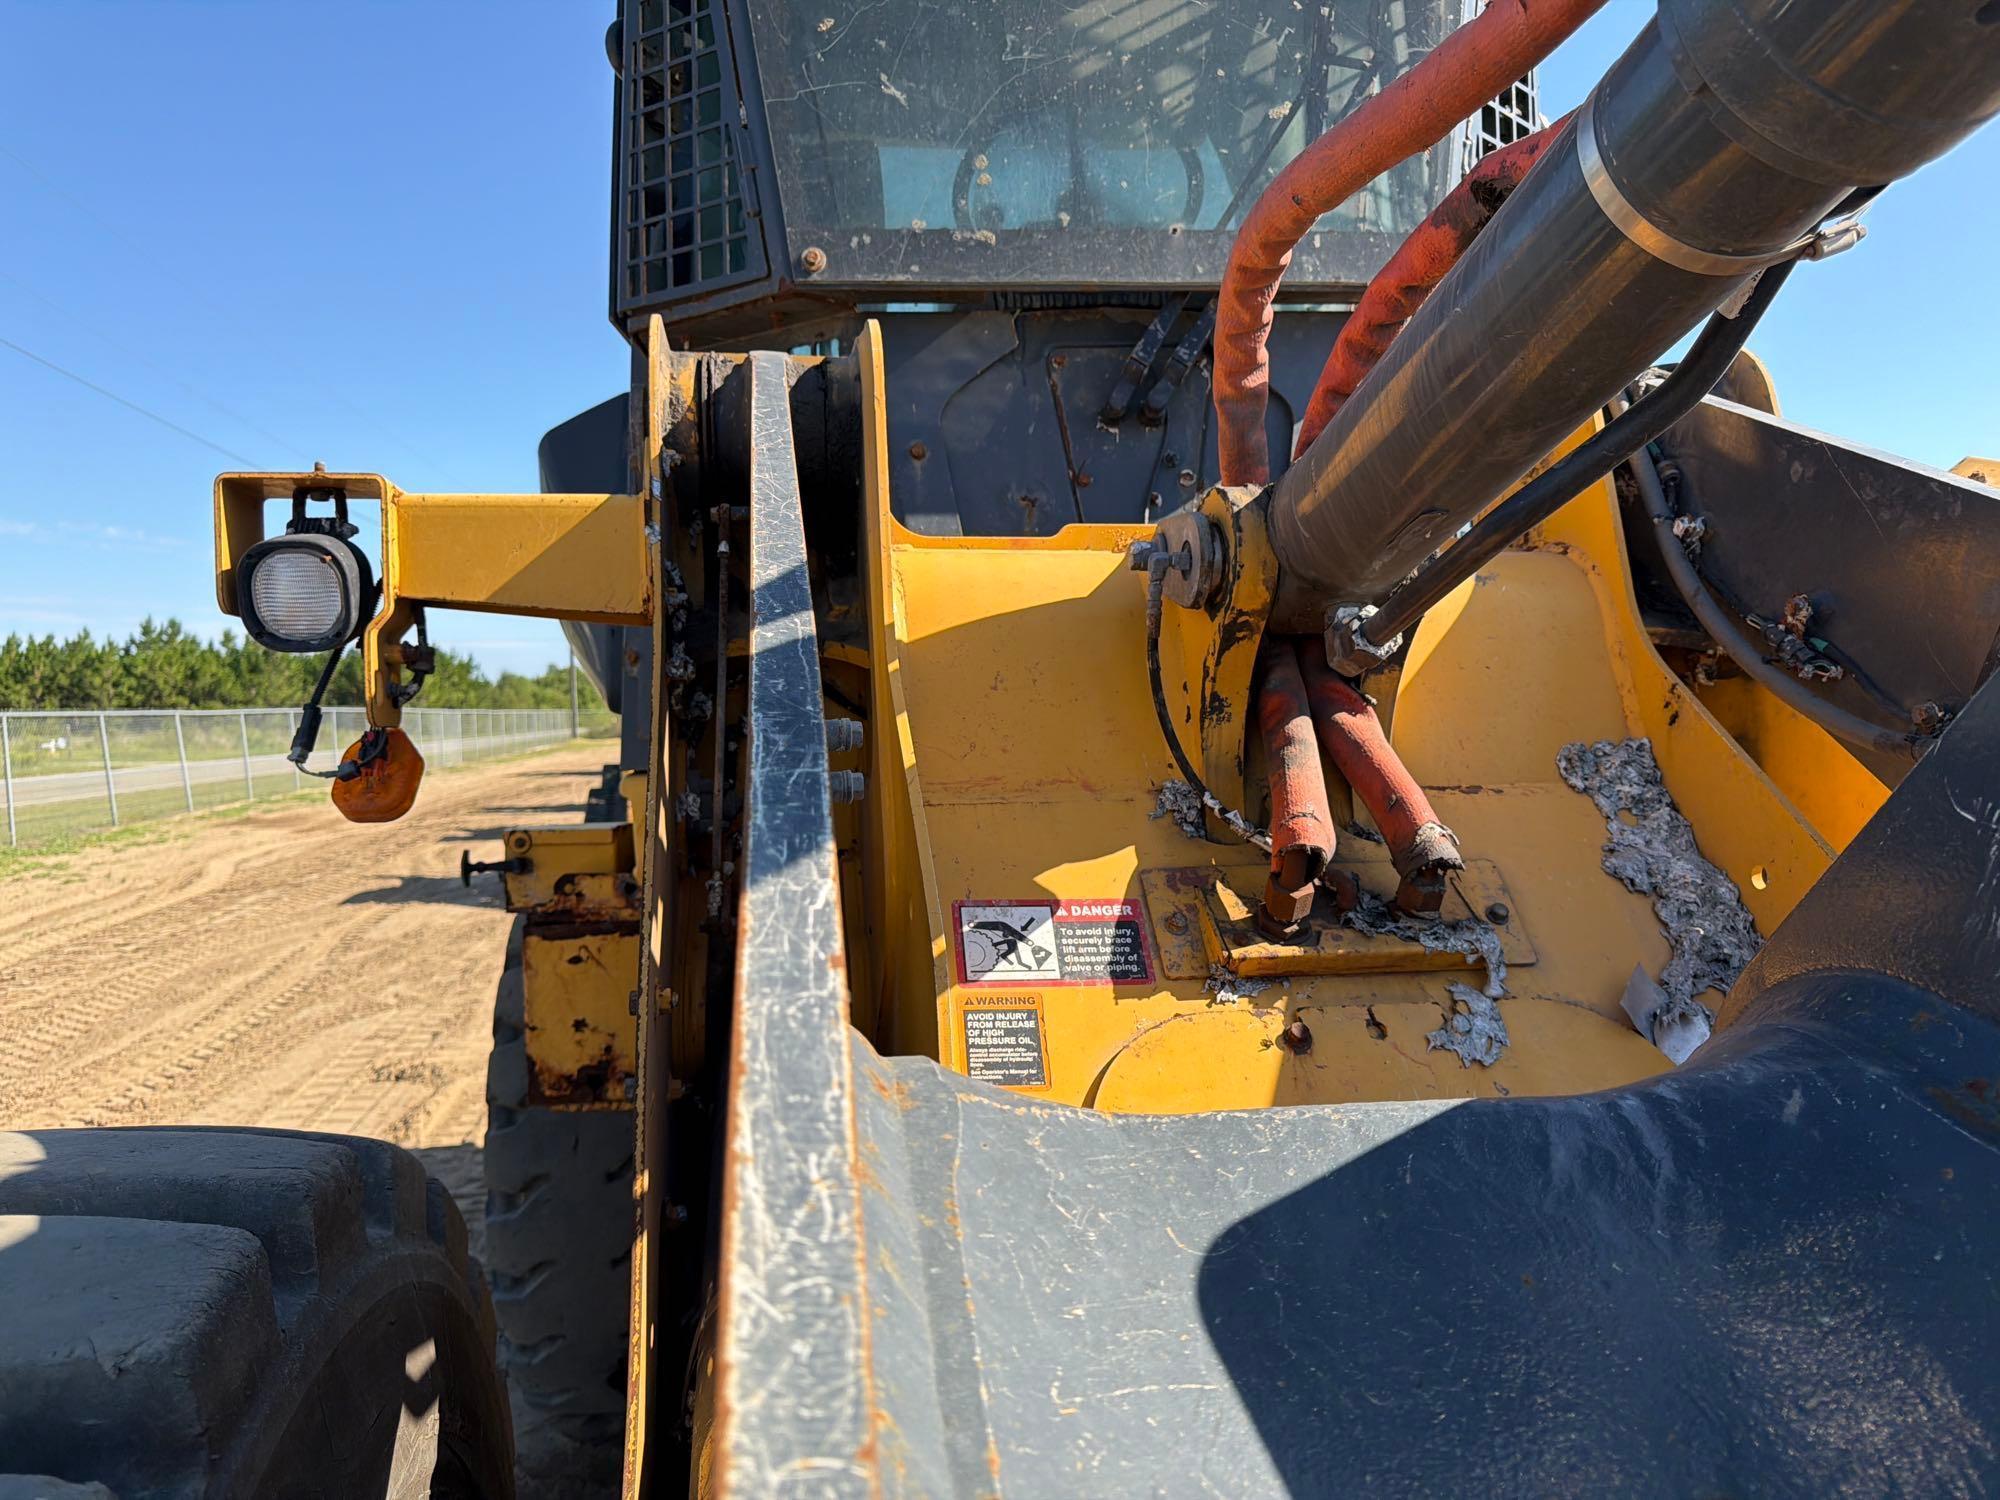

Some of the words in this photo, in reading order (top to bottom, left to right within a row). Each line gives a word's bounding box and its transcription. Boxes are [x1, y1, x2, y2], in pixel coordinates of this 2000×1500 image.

[1071, 906, 1132, 916] DANGER
[1104, 928, 1134, 937] injury,
[1062, 937, 1102, 945] securely
[976, 997, 1035, 1005] WARNING
